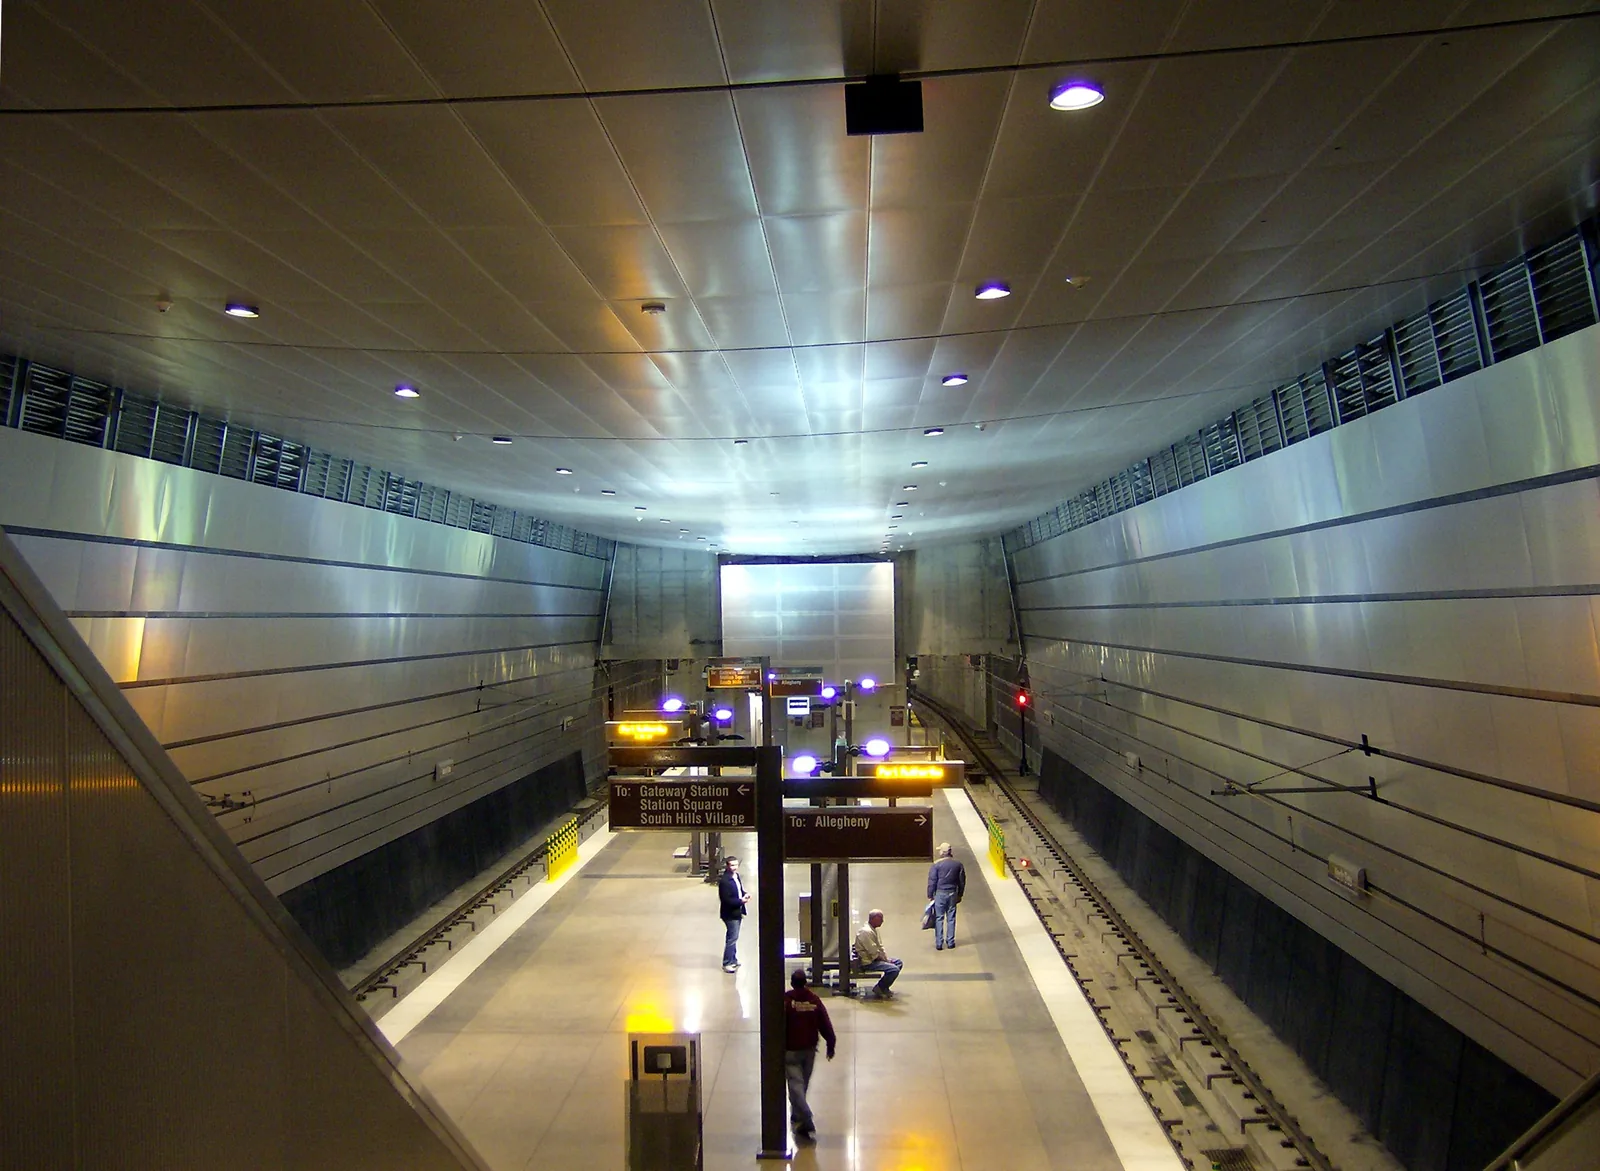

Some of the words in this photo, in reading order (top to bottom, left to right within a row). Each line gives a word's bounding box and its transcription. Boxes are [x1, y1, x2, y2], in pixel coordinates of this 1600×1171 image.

[615, 785, 631, 796] To:
[640, 785, 687, 799] Gateway
[690, 784, 729, 796] Station
[640, 799, 680, 810] Station
[683, 799, 723, 812] Square
[640, 812, 672, 824] South
[675, 812, 702, 824] Hills
[705, 812, 745, 826] Village
[790, 815, 806, 827] To:
[815, 815, 870, 829] Allegheny
